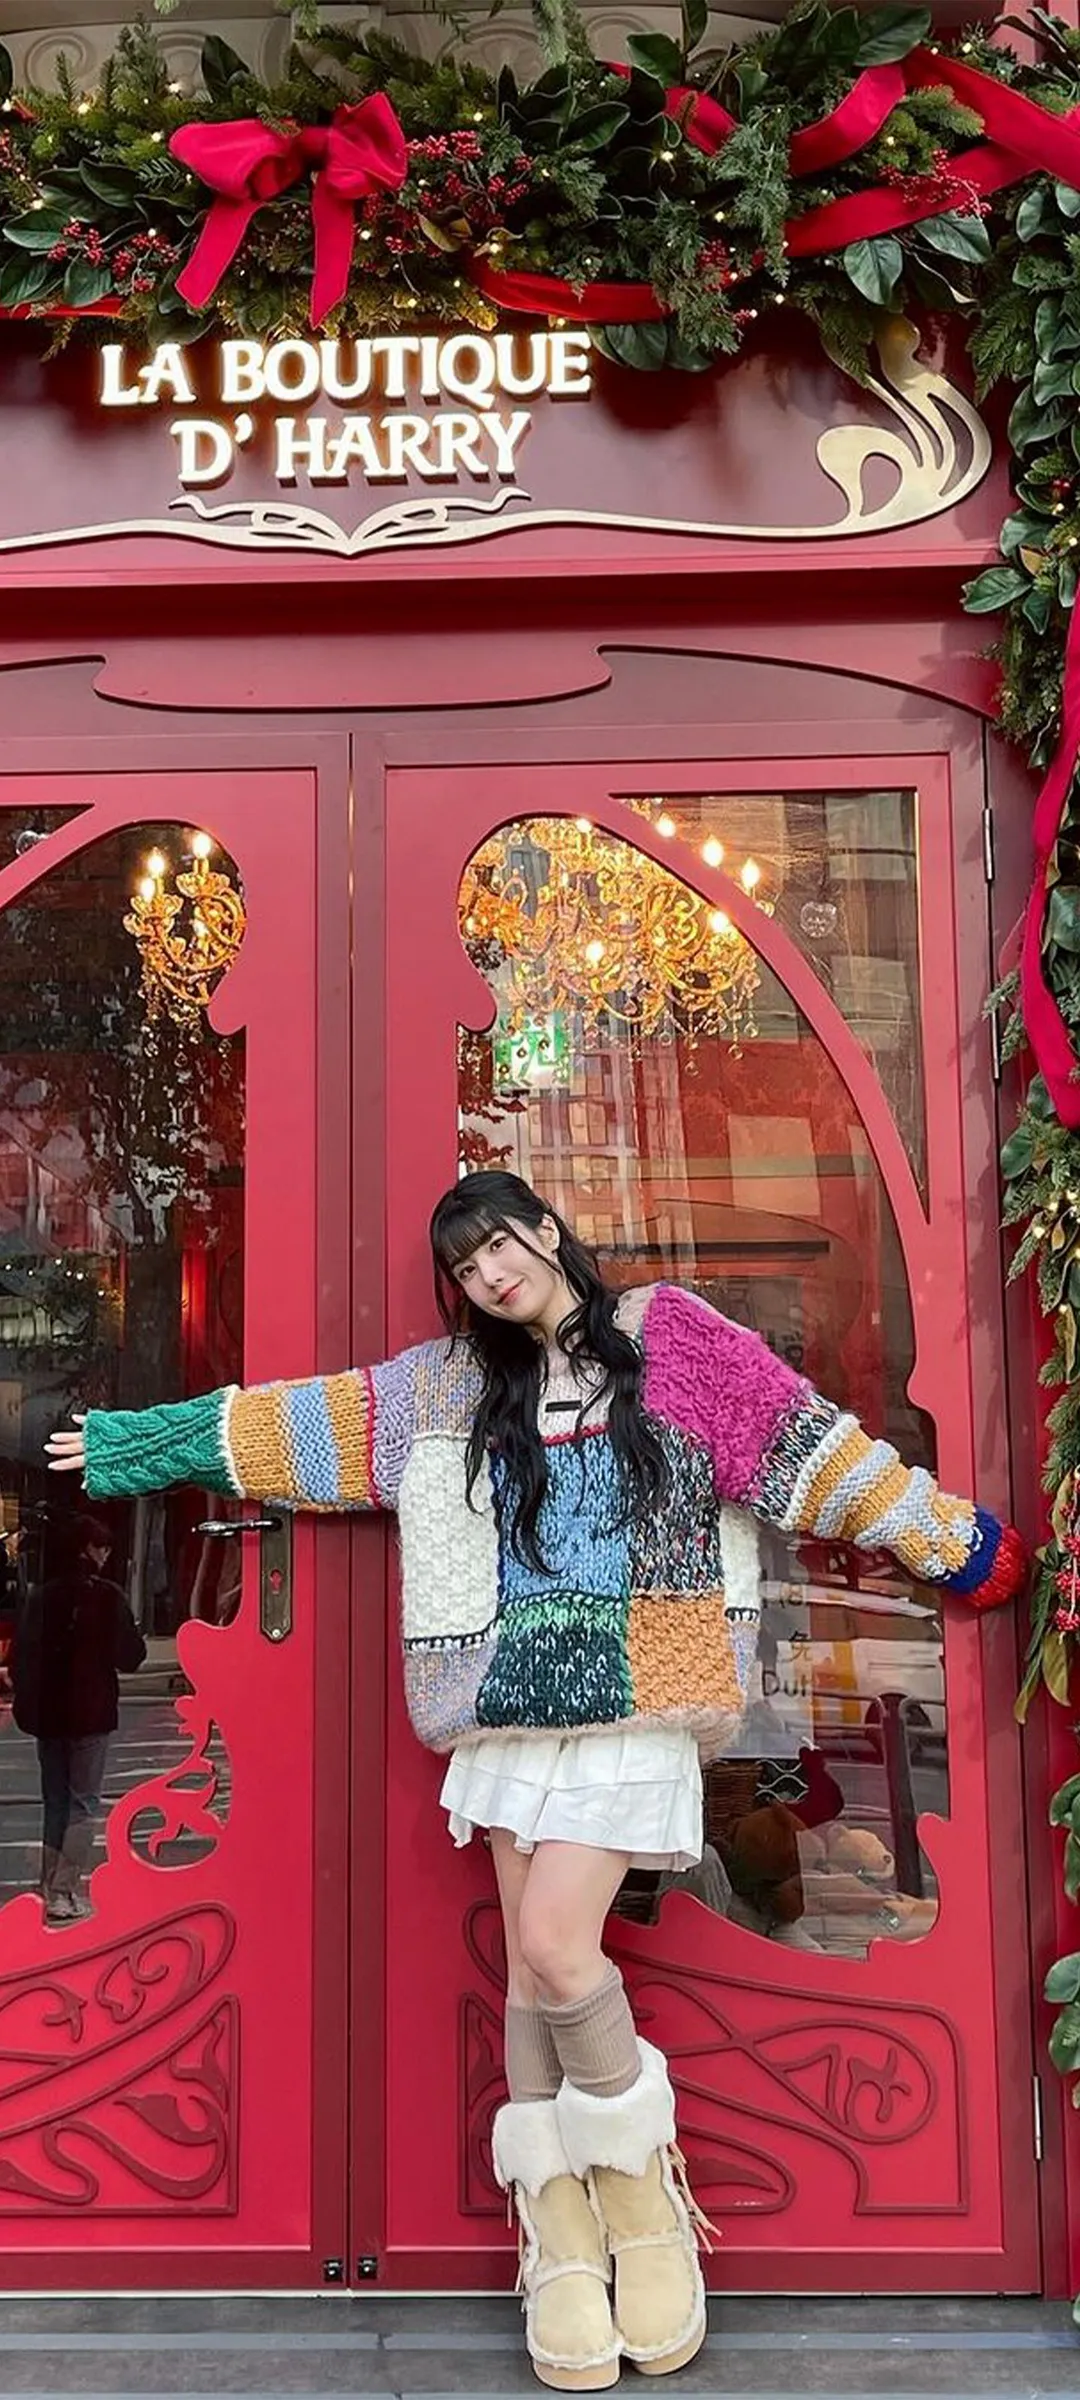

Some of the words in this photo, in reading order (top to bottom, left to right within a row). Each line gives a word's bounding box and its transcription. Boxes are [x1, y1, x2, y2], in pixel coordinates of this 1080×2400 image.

[101, 344, 197, 405] LA
[220, 331, 593, 411] BOUTIQUE
[274, 411, 532, 480] HARRY
